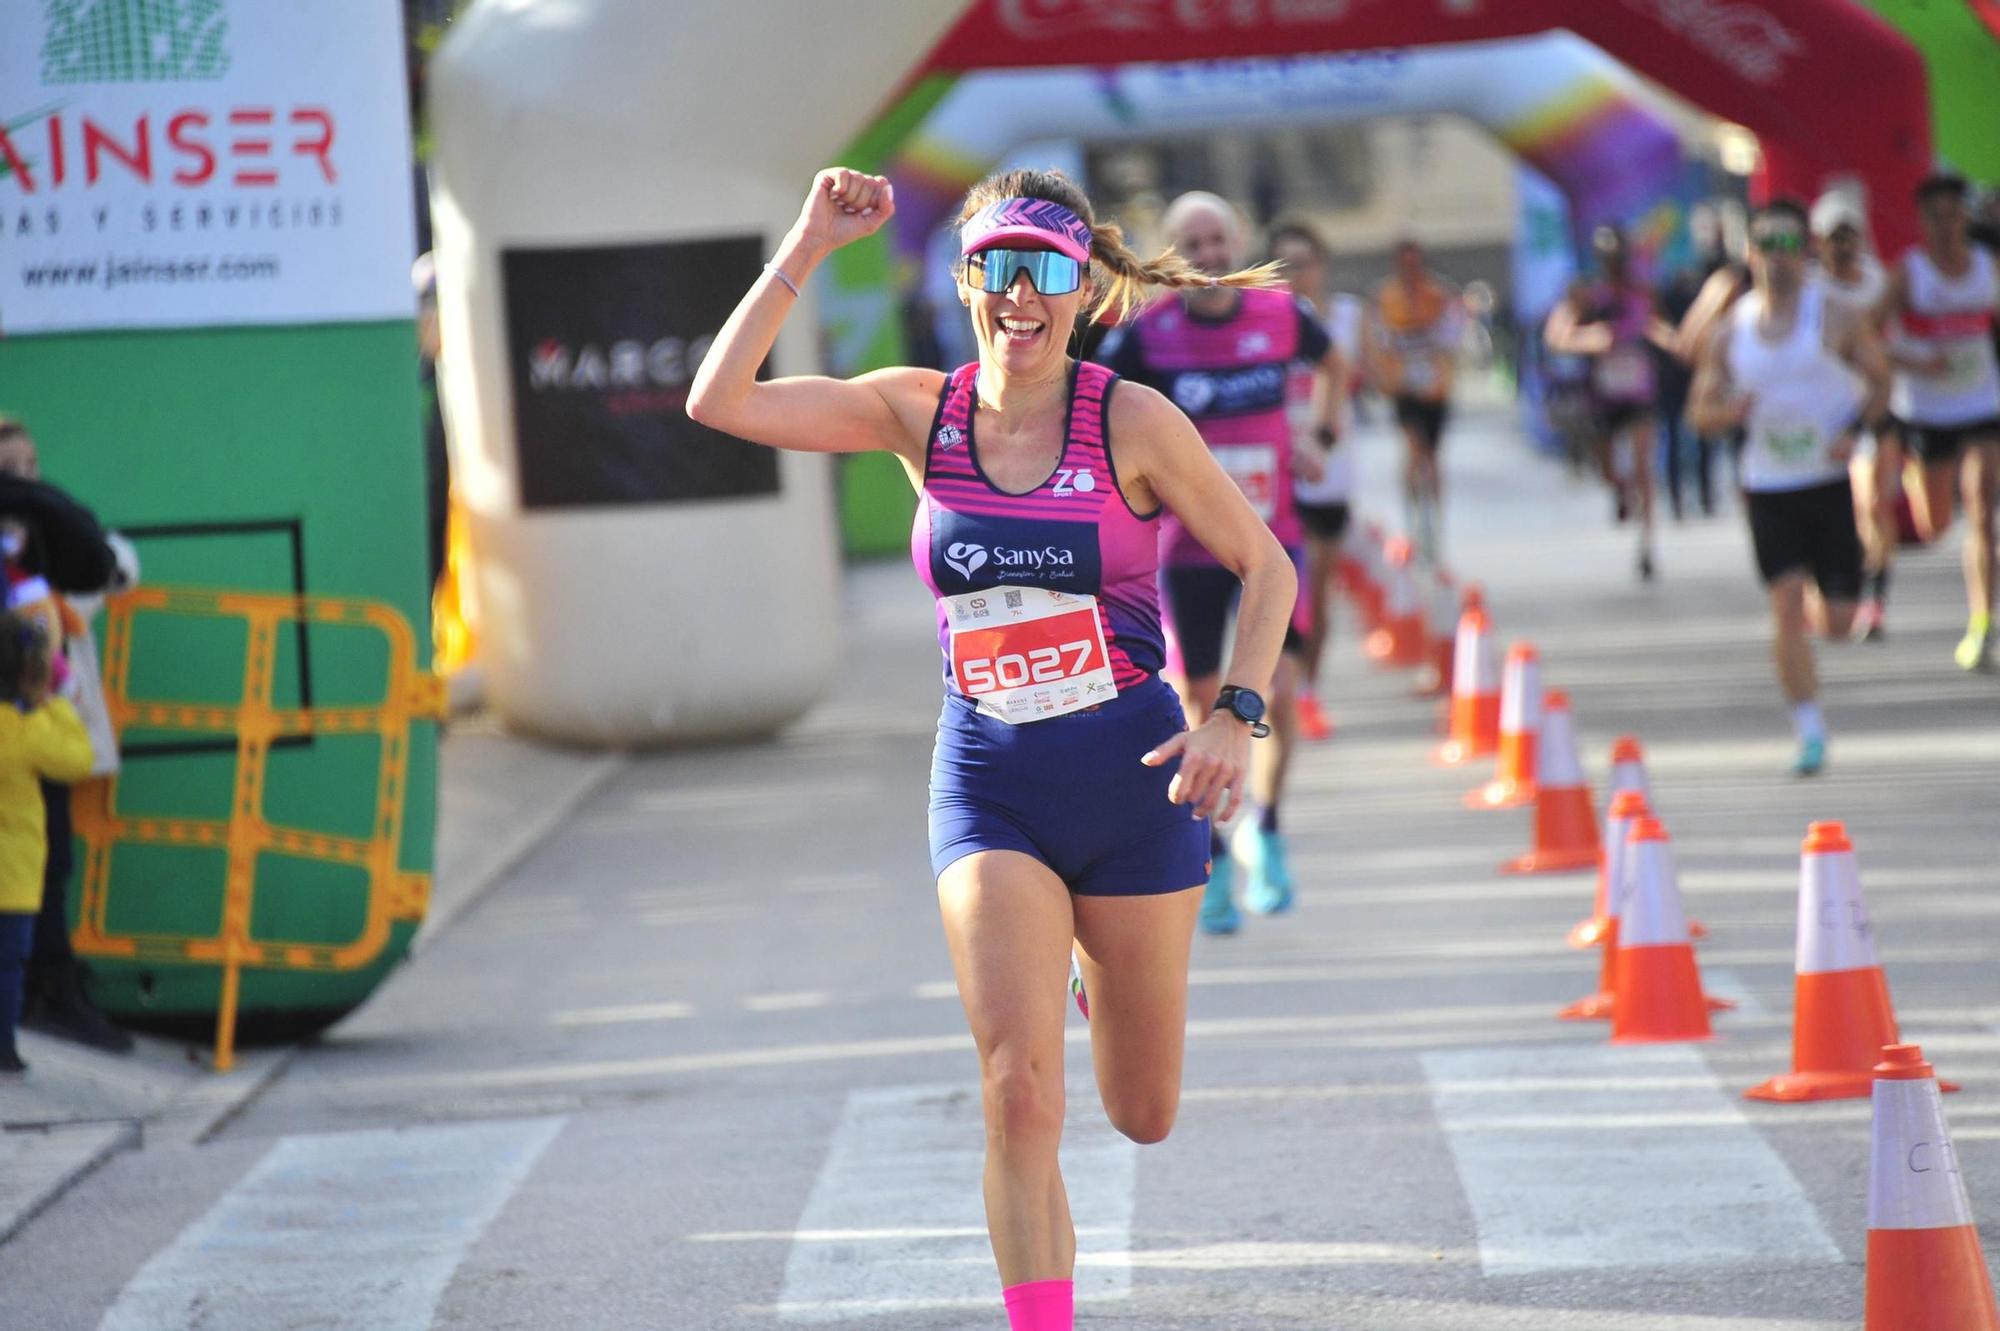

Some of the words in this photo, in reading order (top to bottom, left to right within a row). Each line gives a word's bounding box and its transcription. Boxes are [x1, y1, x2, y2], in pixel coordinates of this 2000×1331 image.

[142, 198, 343, 233] SERVICIOS
[993, 546, 1073, 570] SanySa
[963, 639, 1093, 694] 5027
